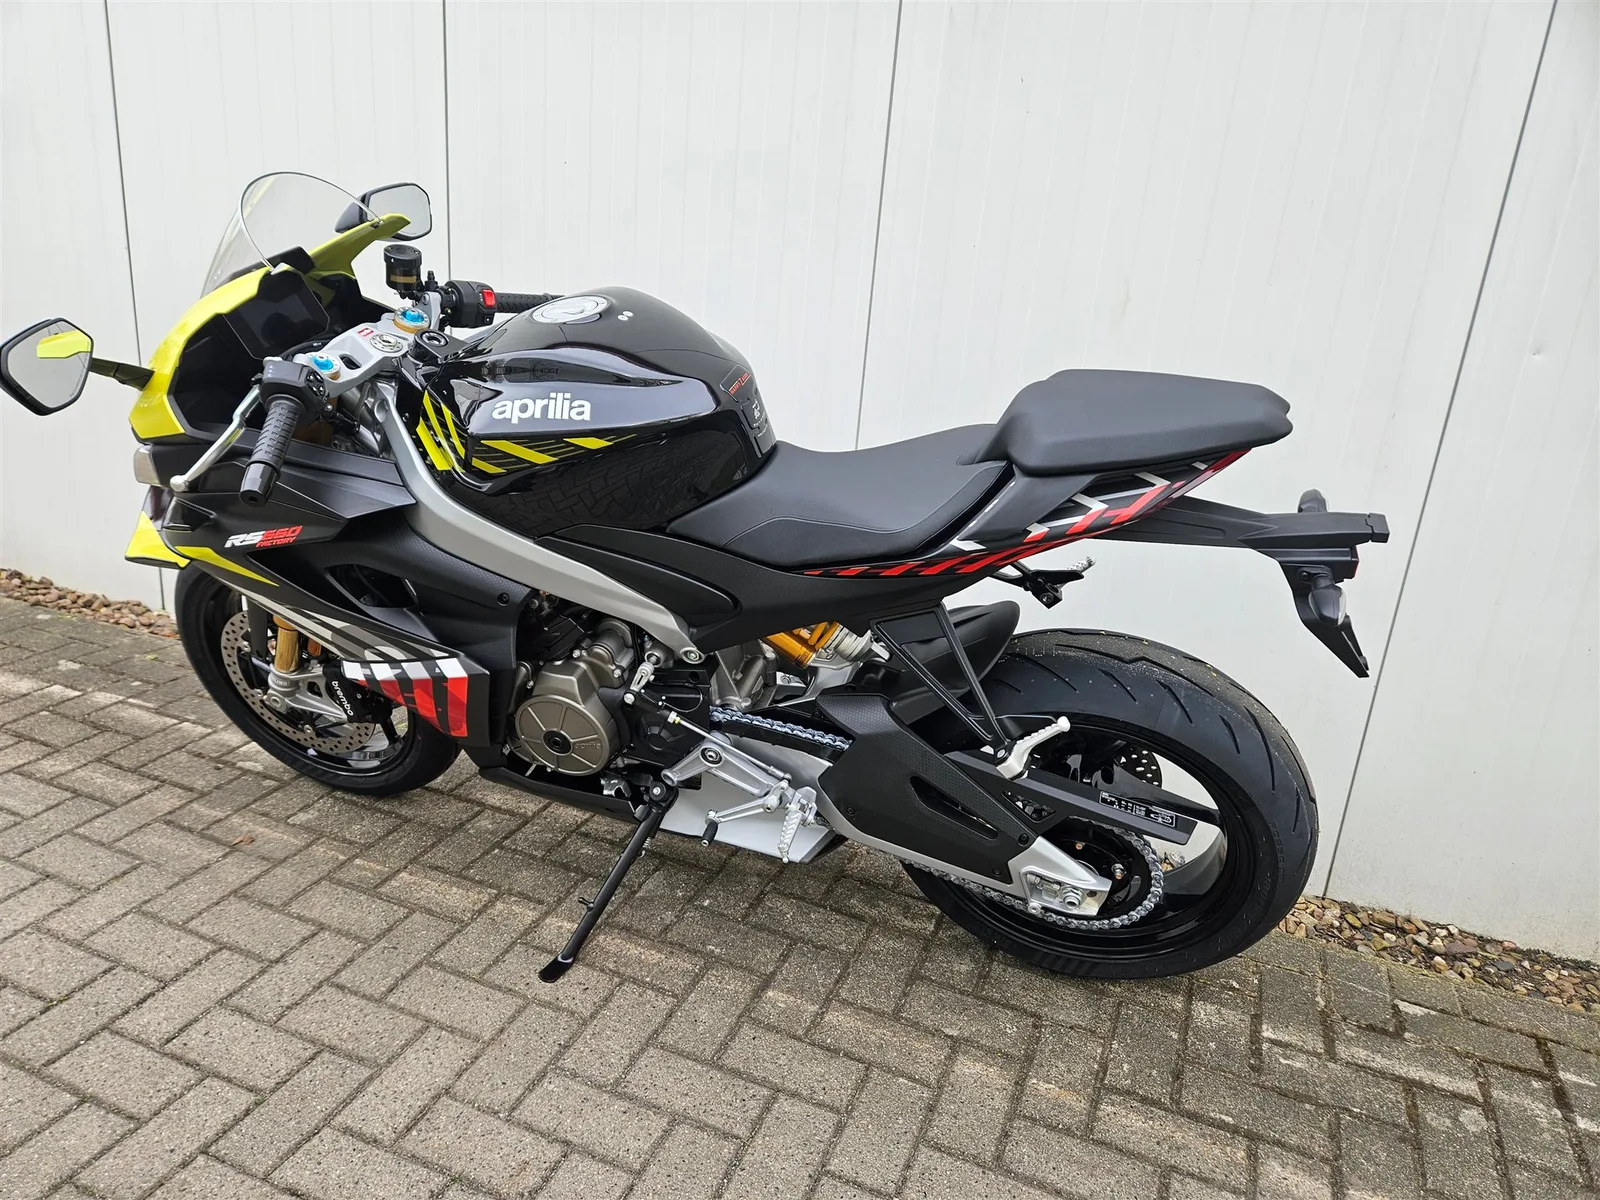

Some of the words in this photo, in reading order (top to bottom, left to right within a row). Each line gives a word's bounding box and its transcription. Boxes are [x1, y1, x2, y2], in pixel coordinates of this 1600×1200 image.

[491, 392, 592, 424] aprilia
[255, 536, 297, 548] FACTORY
[331, 680, 354, 716] brembo
